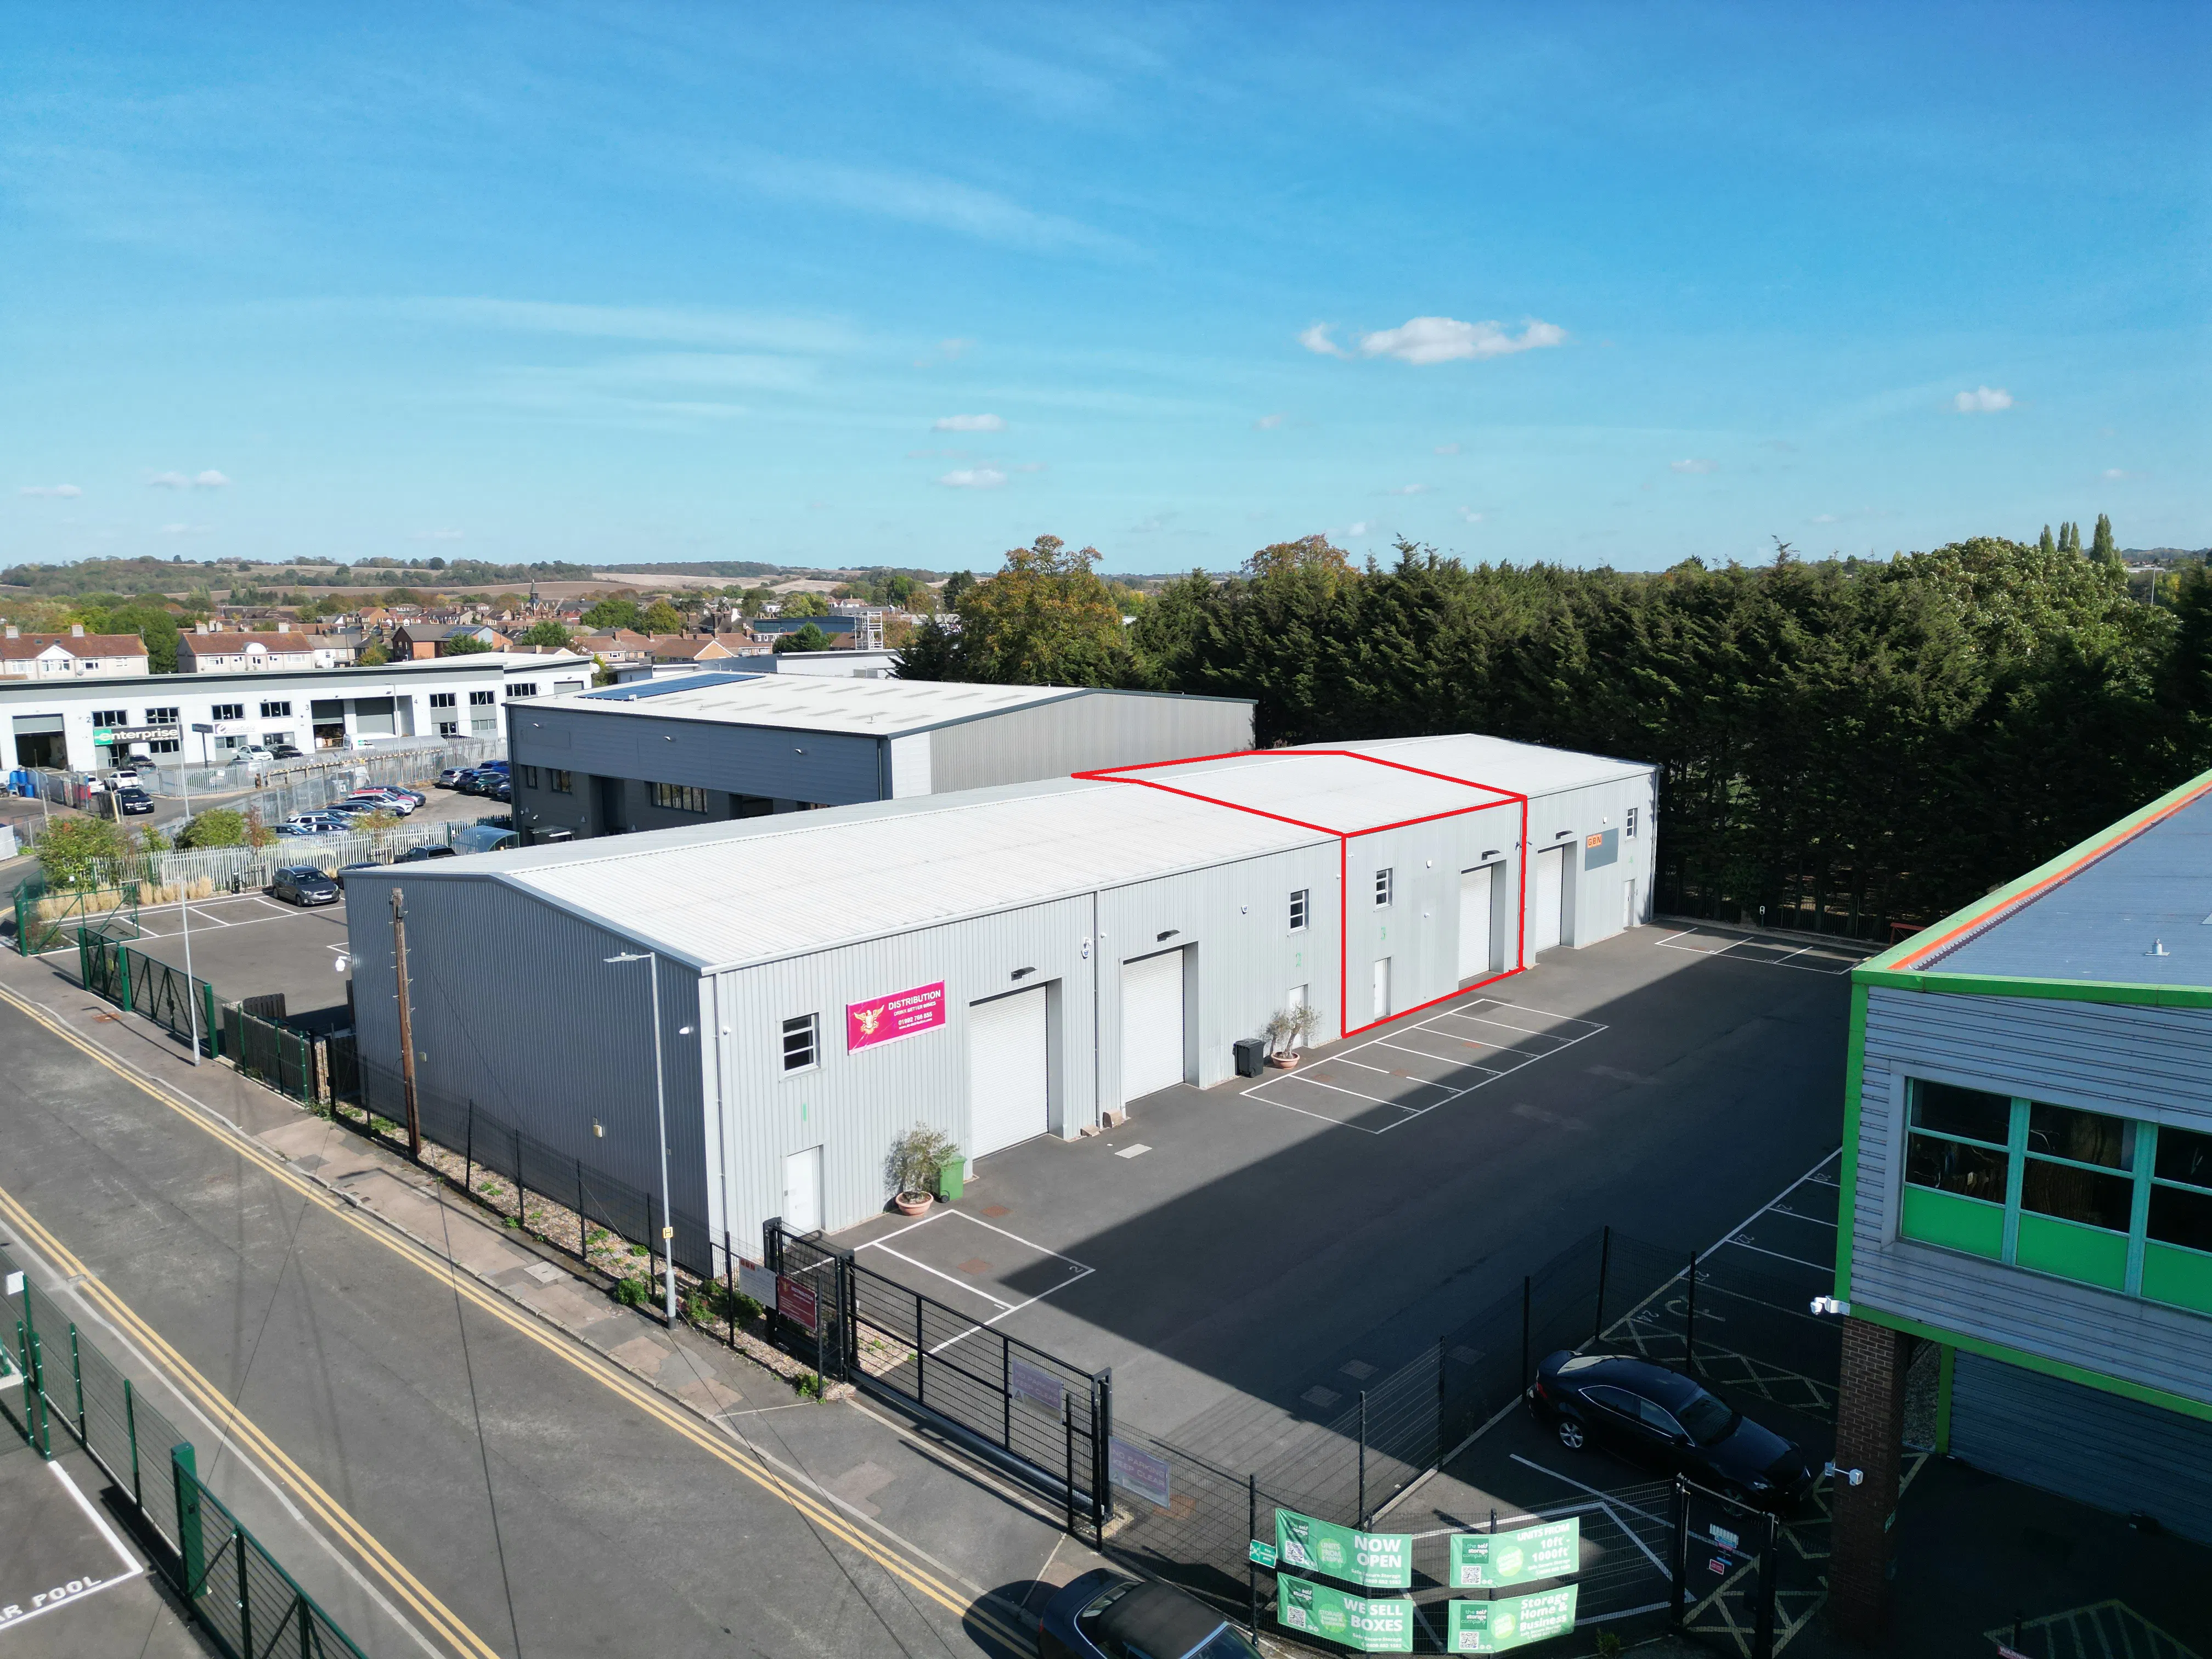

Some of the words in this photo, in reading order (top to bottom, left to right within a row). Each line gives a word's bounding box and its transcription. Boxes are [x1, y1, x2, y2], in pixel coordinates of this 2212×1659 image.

[98, 729, 179, 742] enterprise
[1381, 927, 1386, 940] 3
[1296, 952, 1301, 967] 2
[888, 989, 941, 1011] DISTRIBUTION
[894, 1008, 907, 1017] DRINK
[1734, 1234, 1755, 1244] 22
[1015, 1379, 1034, 1390] KEEP
[1035, 1388, 1059, 1404] CLEAR
[1028, 1375, 1059, 1396] PARKING
[1112, 1449, 1125, 1459] NO
[1127, 1456, 1165, 1479] PARKING
[1113, 1459, 1135, 1471] KEEP
[1137, 1469, 1165, 1486] CLEAR
[1516, 1527, 1544, 1542] UNITS
[1544, 1522, 1570, 1536] FROM
[1321, 1542, 1341, 1550] UNITS
[1355, 1534, 1402, 1553] NOW
[1322, 1549, 1341, 1558] FROM
[1357, 1552, 1402, 1568] OPEN
[31, 1576, 102, 1608] POOL
[1293, 1590, 1312, 1601] storage
[1521, 1592, 1569, 1610] Storage
[1344, 1596, 1366, 1615] WE
[1369, 1604, 1403, 1616] SELL
[1520, 1605, 1556, 1621] Home
[1558, 1601, 1568, 1612] &
[1351, 1614, 1403, 1632] BOXES
[1519, 1614, 1567, 1633] Business
